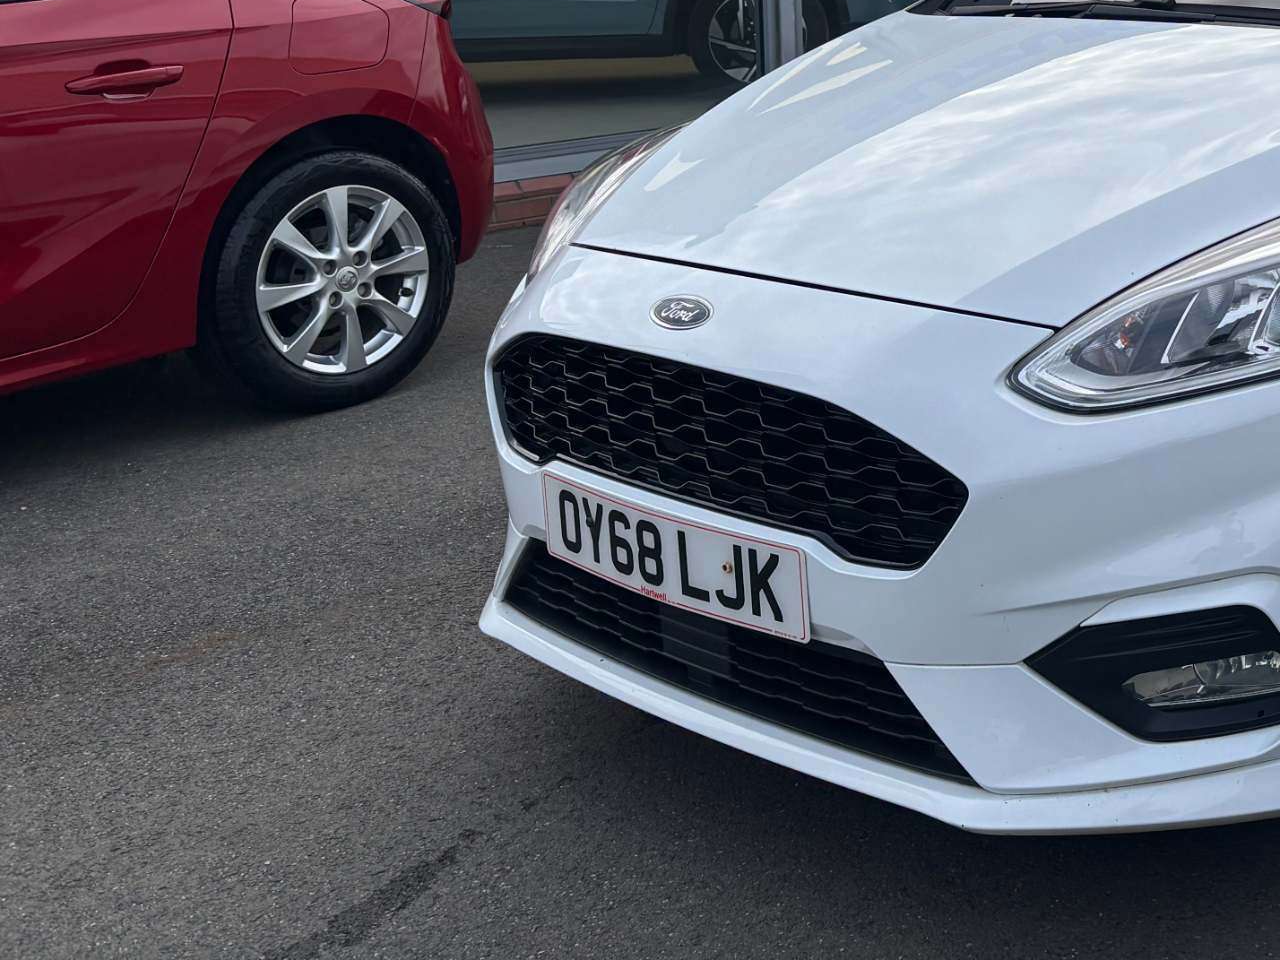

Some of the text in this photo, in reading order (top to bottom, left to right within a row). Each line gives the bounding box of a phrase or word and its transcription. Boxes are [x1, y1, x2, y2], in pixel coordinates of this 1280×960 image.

[661, 301, 700, 321] Ford
[558, 489, 784, 622] OY68 LJK
